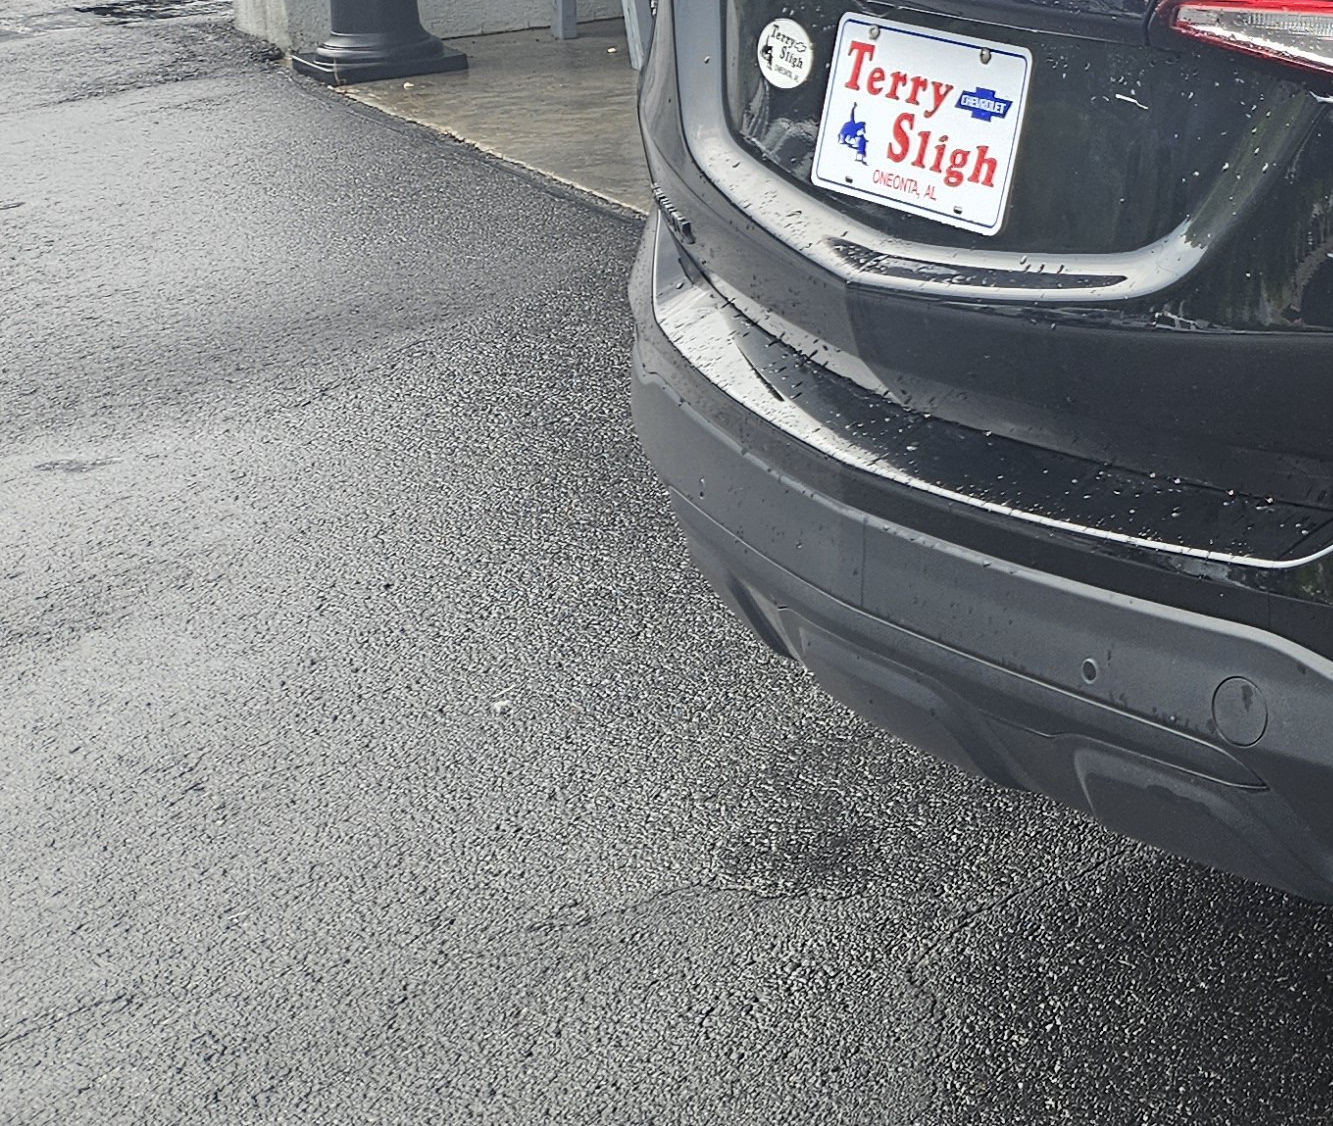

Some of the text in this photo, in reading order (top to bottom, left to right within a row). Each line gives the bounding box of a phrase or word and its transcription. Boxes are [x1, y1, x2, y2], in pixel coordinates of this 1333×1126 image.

[770, 24, 797, 49] Terry
[779, 45, 804, 70] Sligh
[844, 40, 954, 118] Terry
[886, 112, 998, 188] Sligh
[923, 184, 938, 202] AL
